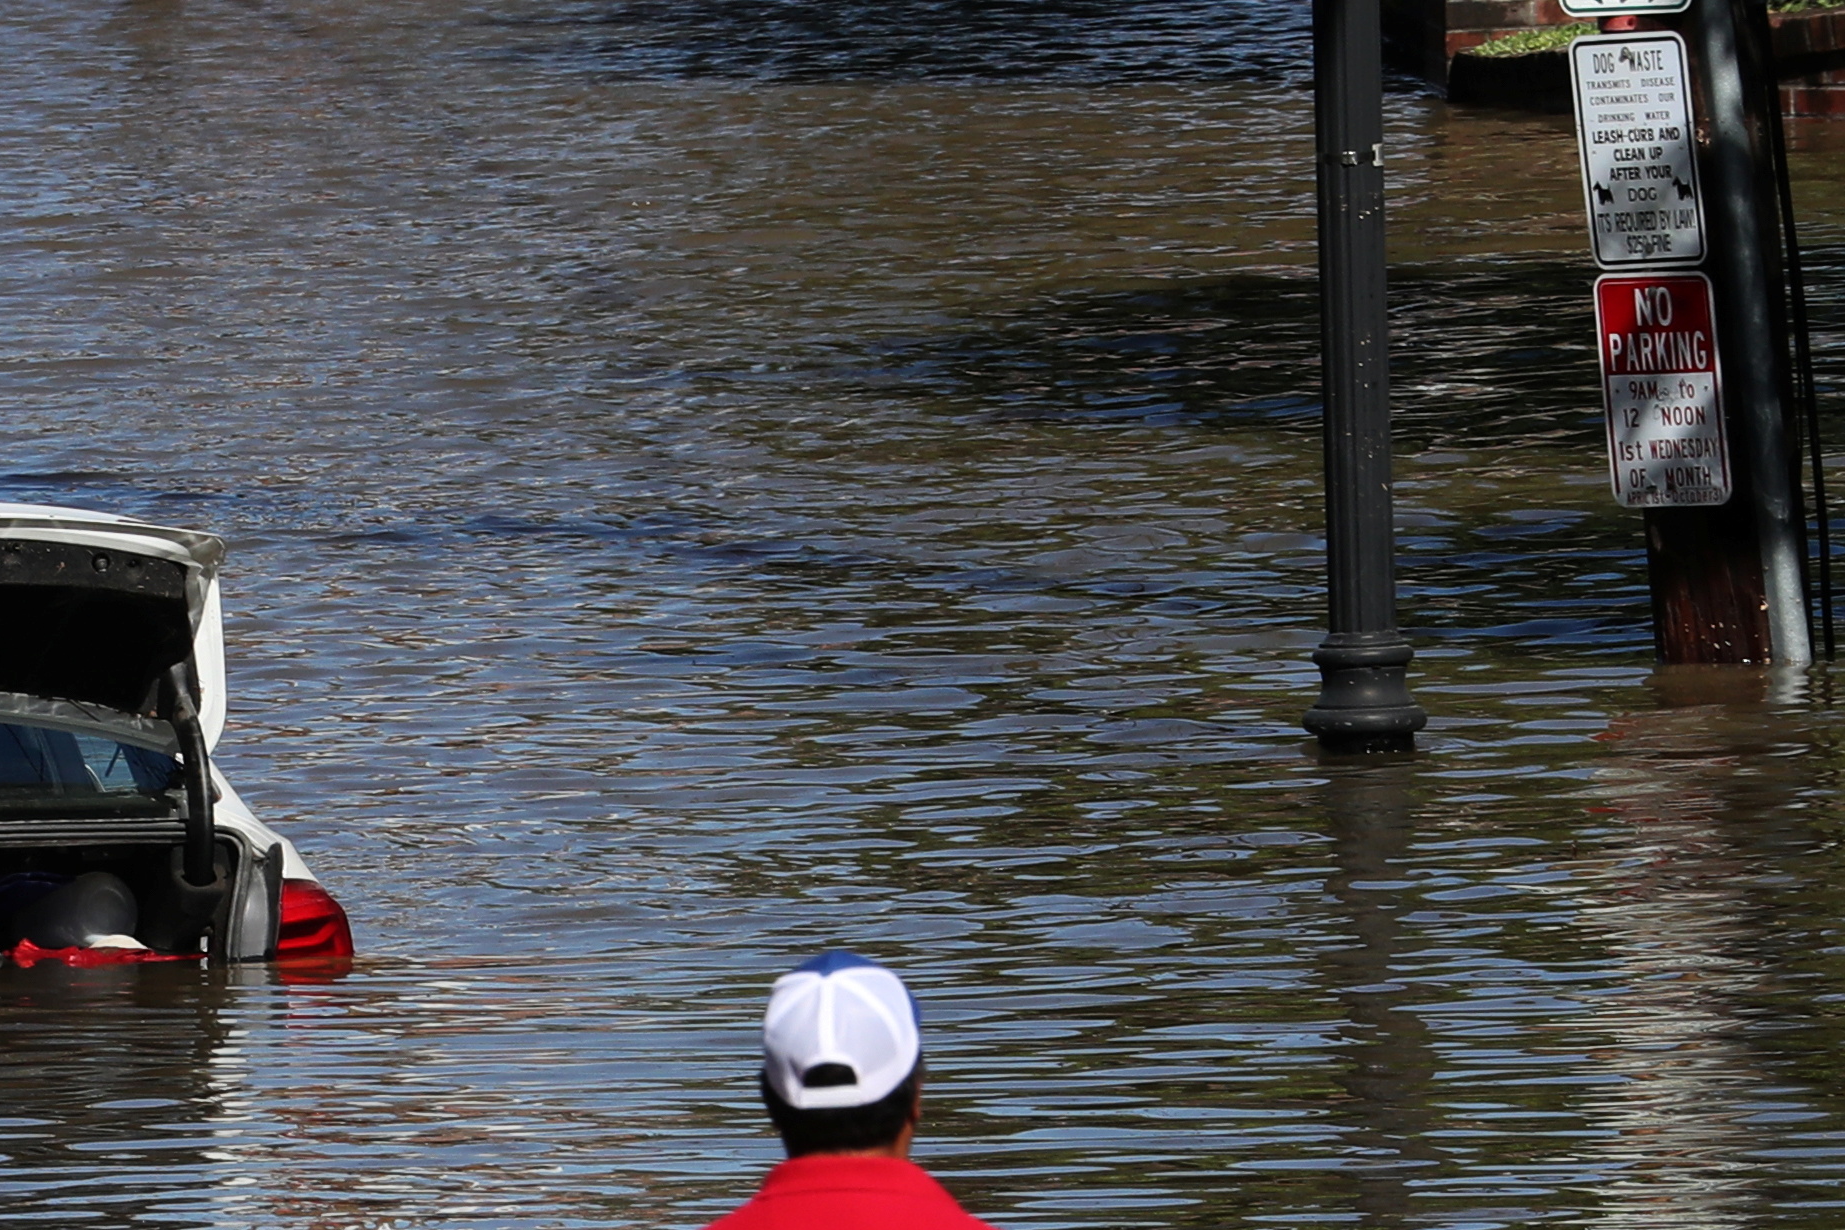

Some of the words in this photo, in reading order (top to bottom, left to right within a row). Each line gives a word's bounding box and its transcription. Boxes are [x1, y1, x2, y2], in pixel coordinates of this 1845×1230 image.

[1593, 53, 1615, 74] DOG
[1629, 50, 1664, 72] WASTE
[1586, 79, 1631, 90] TRANSMITS
[1641, 77, 1676, 88] DISEASE
[1590, 94, 1649, 107] CONTAMINATES
[1658, 92, 1676, 104] OUR
[1598, 112, 1635, 123] DRINKING
[1645, 111, 1671, 121] WATER
[1658, 126, 1681, 141] AND
[1613, 147, 1646, 163] CLEAN
[1649, 146, 1664, 160] UP
[1610, 166, 1642, 181] AFTER
[1645, 164, 1673, 179] YOUR
[1628, 187, 1658, 202] DOG
[1614, 210, 1657, 232] REQUIRED
[1659, 210, 1671, 230] BY
[1651, 233, 1672, 253] FINE
[1633, 286, 1673, 327] NO
[1608, 331, 1706, 371] PARKING
[1629, 381, 1658, 400] 9AM
[1623, 408, 1640, 428] 12
[1660, 406, 1706, 427] NOON
[1619, 440, 1643, 462] 1st
[1648, 437, 1719, 461] WEDNESDAY
[1629, 468, 1647, 488] OF
[1664, 466, 1712, 489] MONTH
